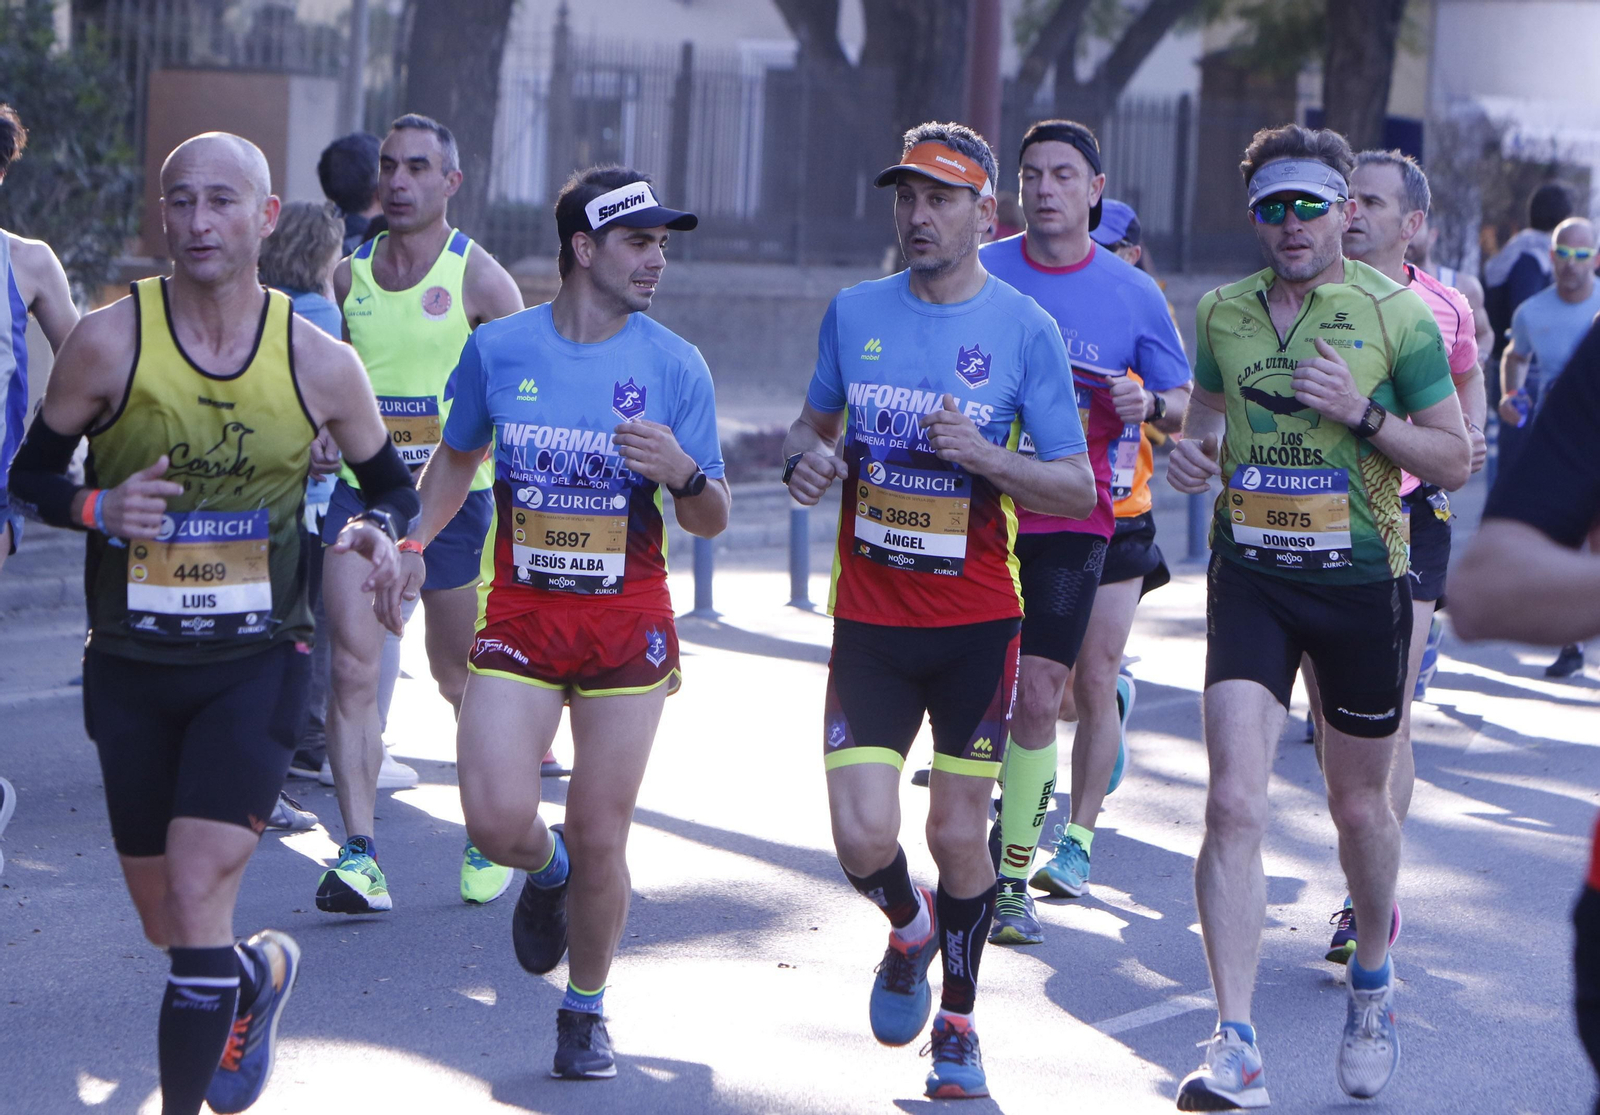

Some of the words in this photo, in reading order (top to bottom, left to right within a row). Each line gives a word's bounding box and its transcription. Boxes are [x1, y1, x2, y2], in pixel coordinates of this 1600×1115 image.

[598, 191, 645, 222] Santini
[1319, 322, 1356, 331] SURAL
[1067, 338, 1099, 361] US
[1265, 357, 1299, 370] ULTRA
[393, 430, 412, 443] 03
[503, 423, 621, 457] INFORMAL
[855, 432, 886, 447] MAIRENA
[889, 439, 909, 450] DEL
[916, 442, 939, 454] ALC
[1281, 432, 1303, 447] LOS
[402, 449, 430, 460] RLOS
[1249, 444, 1324, 466] ALCORES
[509, 470, 547, 484] MAIRENA
[551, 476, 570, 486] DEL
[577, 478, 610, 490] ALCOR
[889, 472, 955, 492] ZURICH
[1265, 474, 1332, 490] ZURICH
[547, 494, 613, 510] ZURICH
[885, 507, 931, 529] 3883
[1266, 510, 1311, 528] 5875
[176, 519, 253, 537] ZURICH
[545, 530, 590, 548] 5897
[884, 530, 925, 550] ÁNGEL
[1262, 533, 1315, 548] DONOSO
[528, 554, 566, 570] JESÚS
[570, 558, 604, 571] ALBA
[173, 562, 227, 582] 4489
[934, 568, 958, 576] ZURICH
[182, 594, 217, 609] LUIS
[971, 751, 992, 759] mobel
